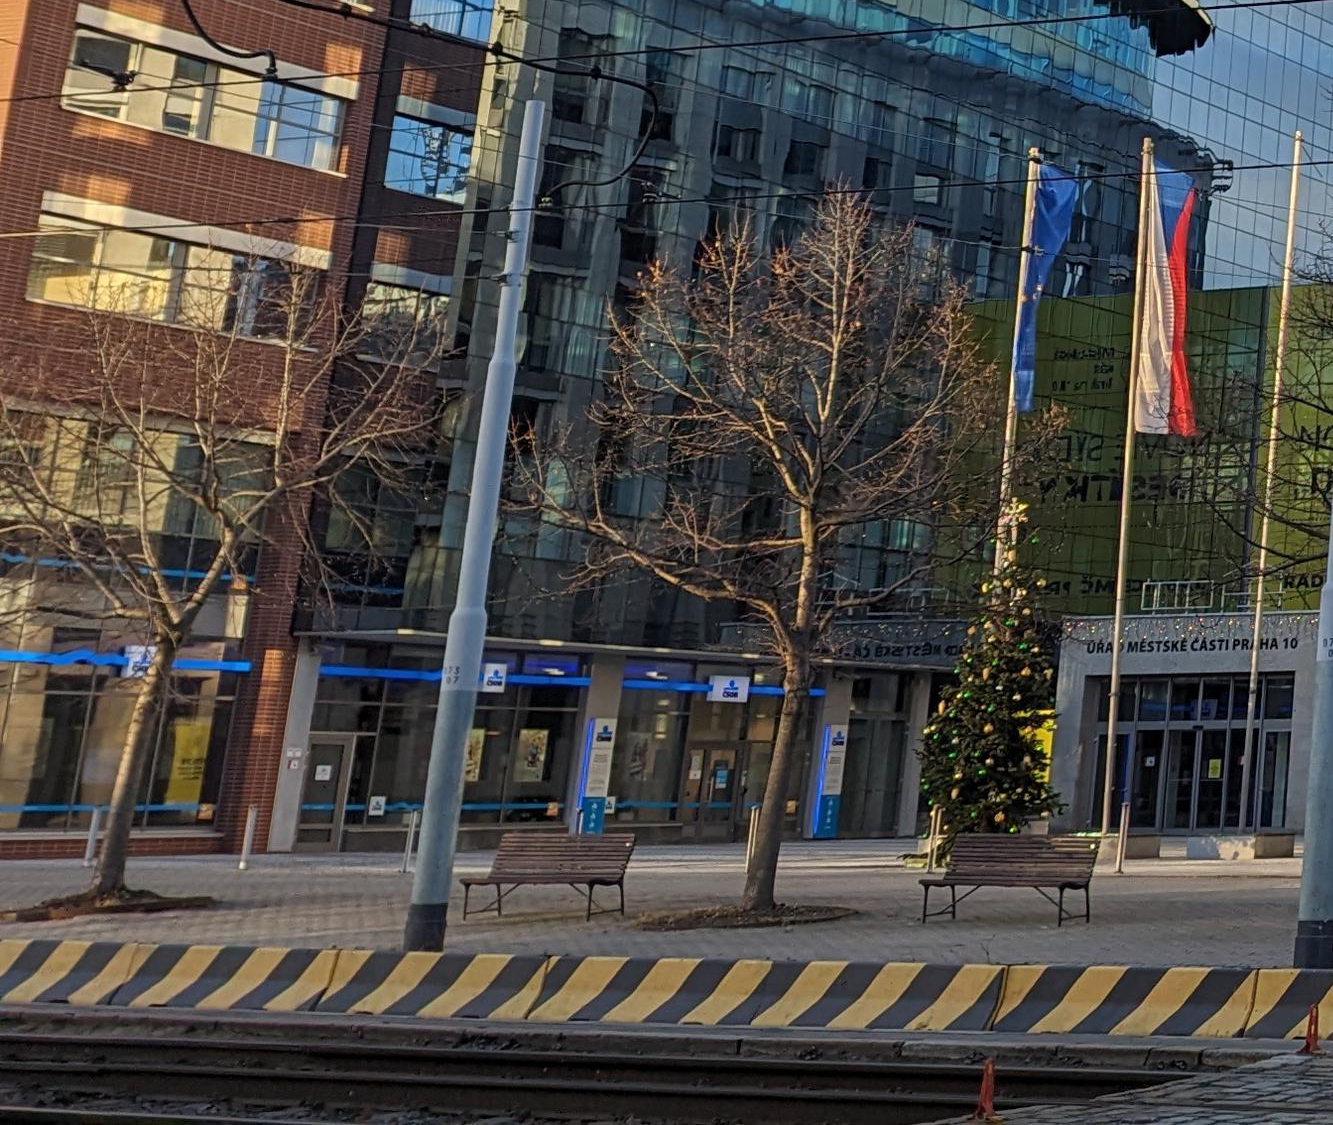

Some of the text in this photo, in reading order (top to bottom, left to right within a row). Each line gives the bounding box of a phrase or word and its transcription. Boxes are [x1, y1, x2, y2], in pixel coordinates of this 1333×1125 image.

[1127, 637, 1188, 653] MĚSTSKÉ
[1190, 637, 1229, 652] ČÁSTI
[1283, 638, 1298, 650] 10
